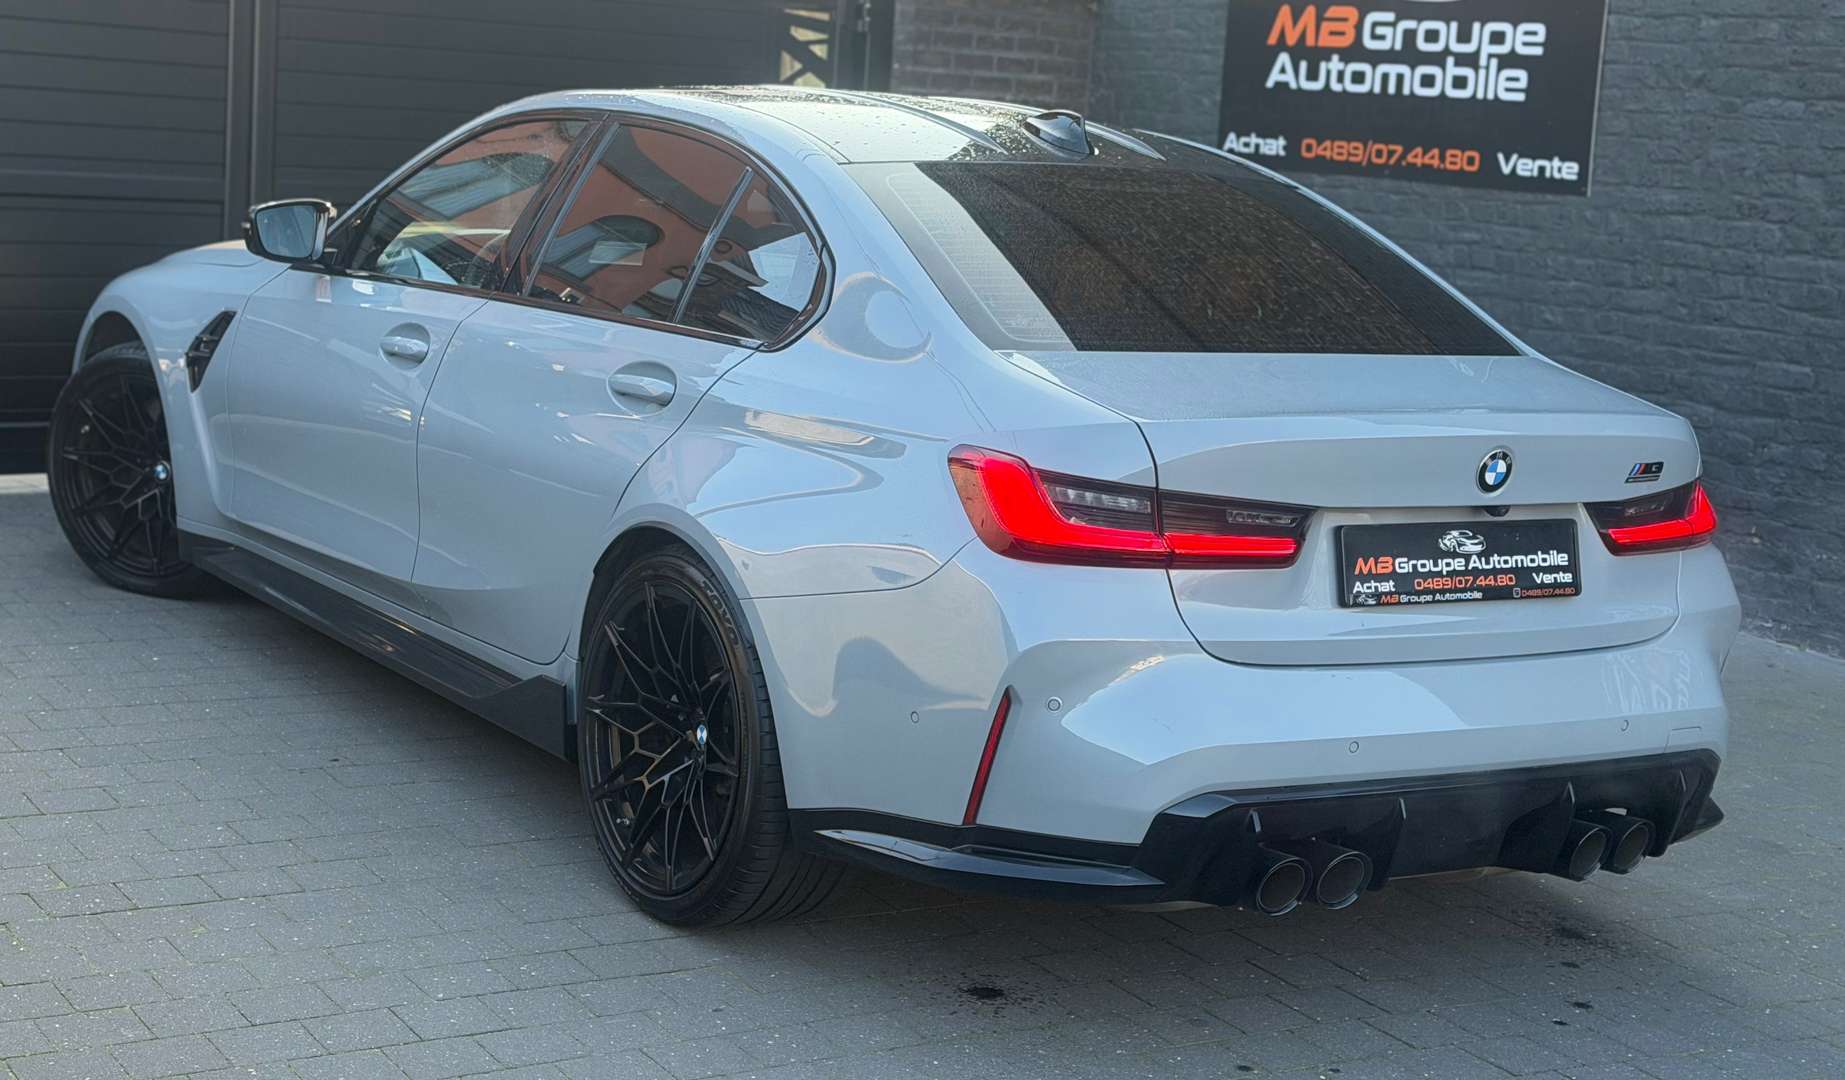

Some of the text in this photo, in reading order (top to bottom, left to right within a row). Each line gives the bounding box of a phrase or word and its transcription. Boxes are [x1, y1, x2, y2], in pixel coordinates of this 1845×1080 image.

[1265, 51, 1529, 102] Automobile
[1223, 131, 1580, 181] Achat 0489/07.44.80 Vente
[1468, 550, 1569, 570] Automobile
[1353, 571, 1573, 594] Achat 0489/07.44.80 Vente
[1434, 591, 1482, 601] Automobile
